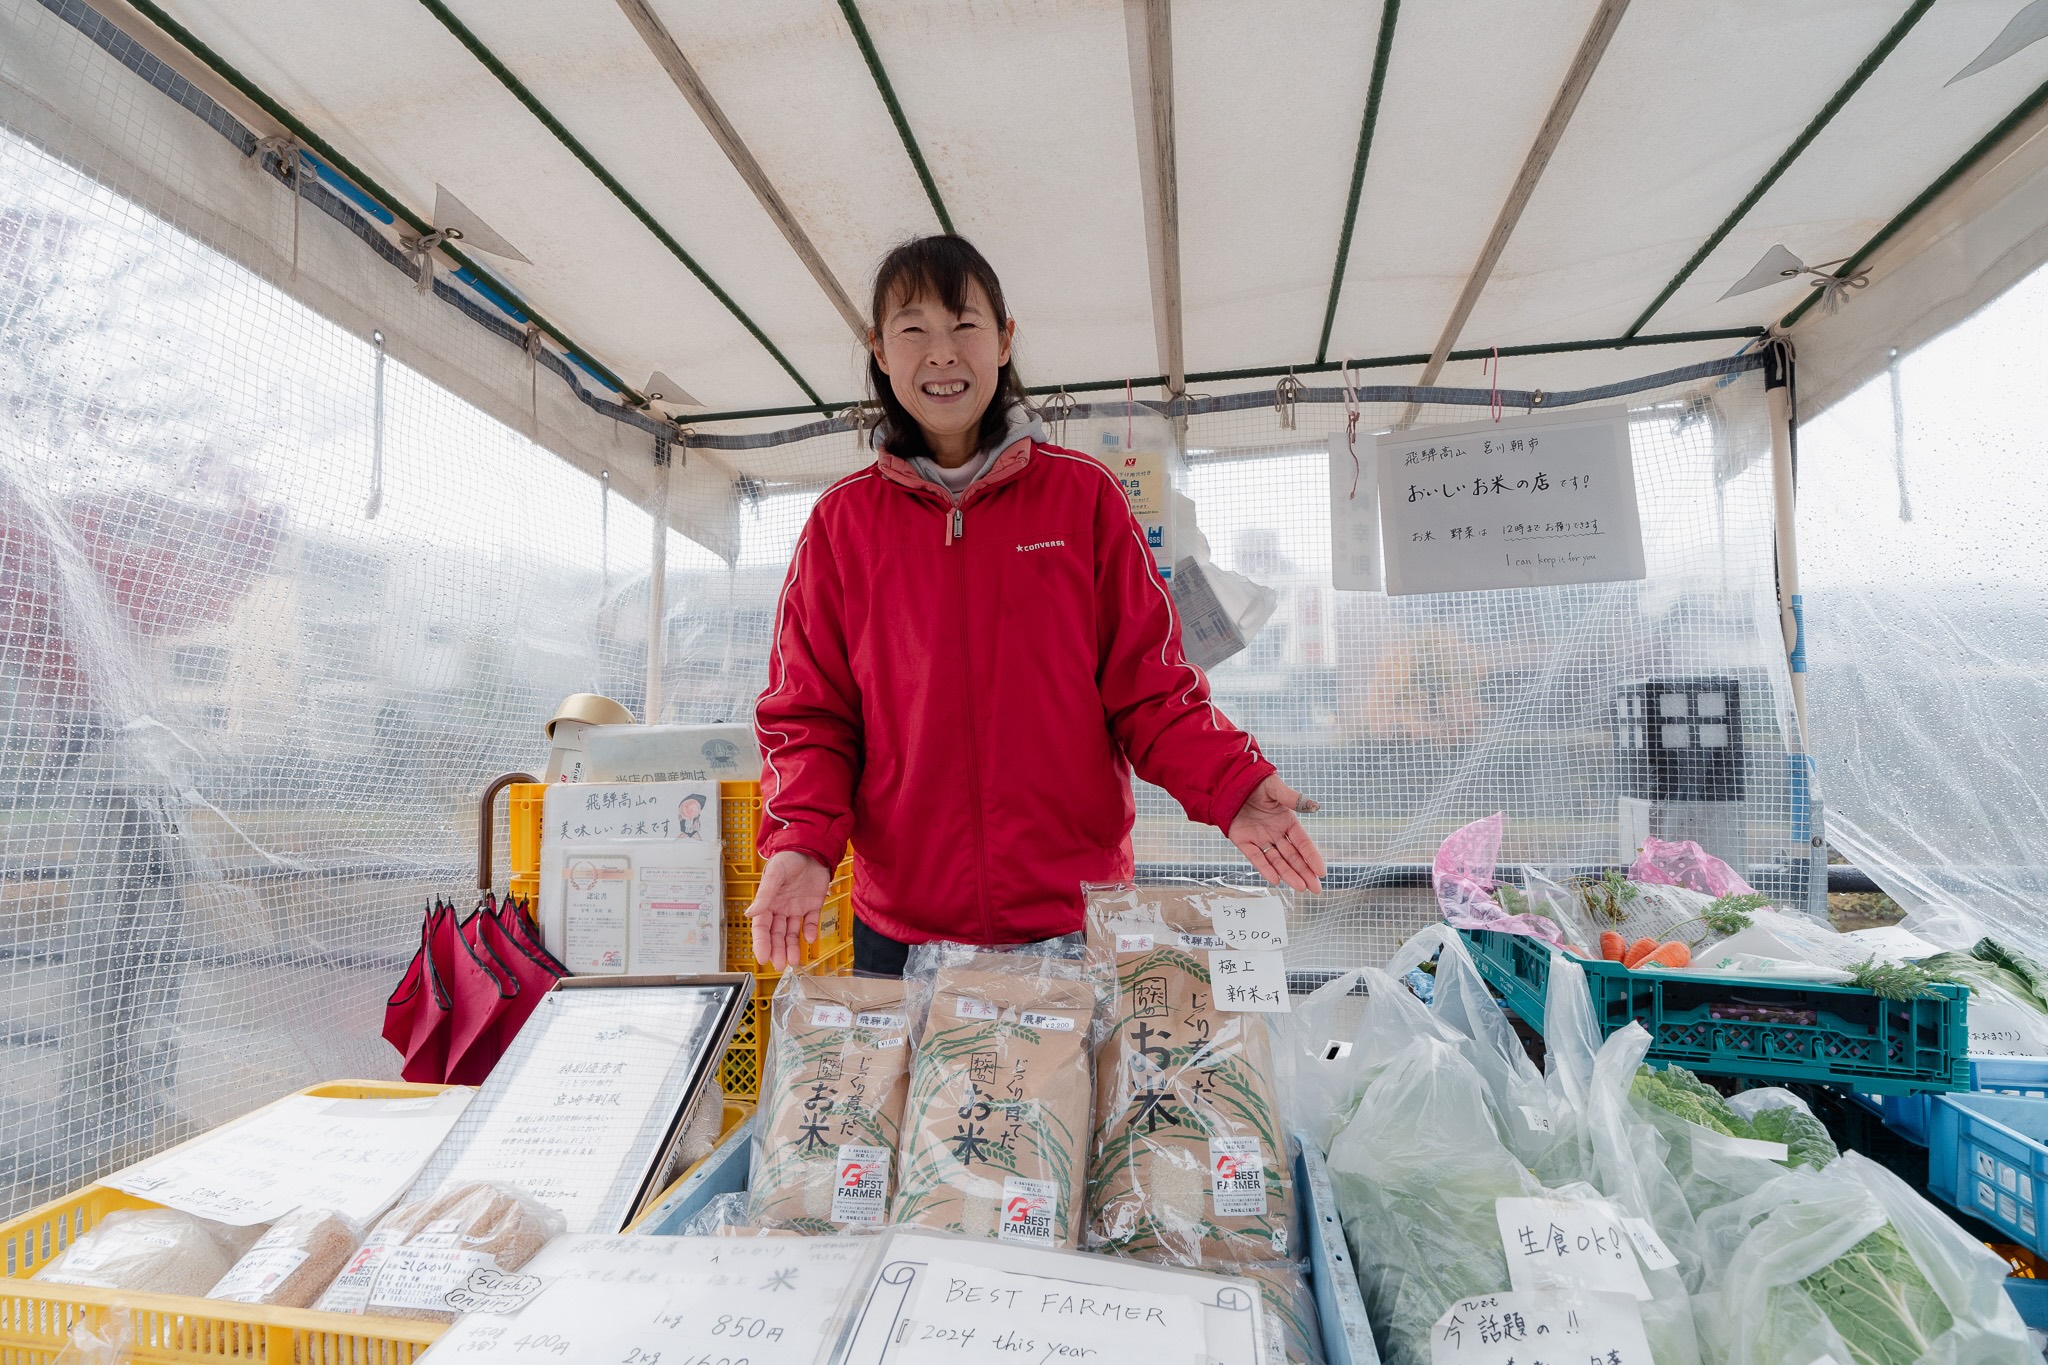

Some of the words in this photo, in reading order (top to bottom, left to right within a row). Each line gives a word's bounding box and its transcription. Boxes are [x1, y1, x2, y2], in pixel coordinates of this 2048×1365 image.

[1404, 446, 1467, 467] 飛騨高山
[1484, 437, 1539, 454] 宮川朝市
[1024, 540, 1065, 552] CONVERSE
[1149, 536, 1161, 544] SSS
[1516, 558, 1531, 566] can
[1538, 553, 1556, 568] keep
[1568, 552, 1580, 562] for
[1582, 554, 1597, 567] you
[586, 793, 657, 811] 飛騨高山の
[1120, 938, 1149, 949] 新米
[1180, 935, 1225, 947] 飛騨高山
[1218, 959, 1255, 974] 極上
[1227, 985, 1280, 1005] 新米です
[962, 1001, 992, 1015] 新米
[818, 1012, 846, 1023] 新米
[881, 1038, 898, 1047] ¥1,600
[558, 1062, 627, 1074] 特別優秀賞
[1128, 1021, 1181, 1132] お米
[840, 1057, 872, 1136] じっくり育てた
[795, 1081, 838, 1151] お米
[952, 1083, 995, 1166] お米
[1235, 1171, 1260, 1180] BEST
[857, 1180, 884, 1190] BEST
[1217, 1181, 1261, 1190] FARMER
[838, 1188, 882, 1199] FARMER
[1024, 1216, 1051, 1227] BEST
[1004, 1223, 1050, 1238] FARMER
[357, 1265, 378, 1275] BEST
[399, 1261, 452, 1275] こしひかり
[337, 1276, 371, 1287] FARMER
[477, 1275, 531, 1292] sushi
[758, 1267, 799, 1292] 米
[946, 1278, 1023, 1309] BEST
[1041, 1293, 1166, 1327] FARMER
[653, 1311, 683, 1329] 1kg
[711, 1315, 784, 1343] 850円
[514, 1334, 569, 1356] 400円
[921, 1325, 976, 1348] 2024
[993, 1330, 1034, 1353] this
[1040, 1342, 1097, 1365] year
[622, 1348, 661, 1365] 2kg
